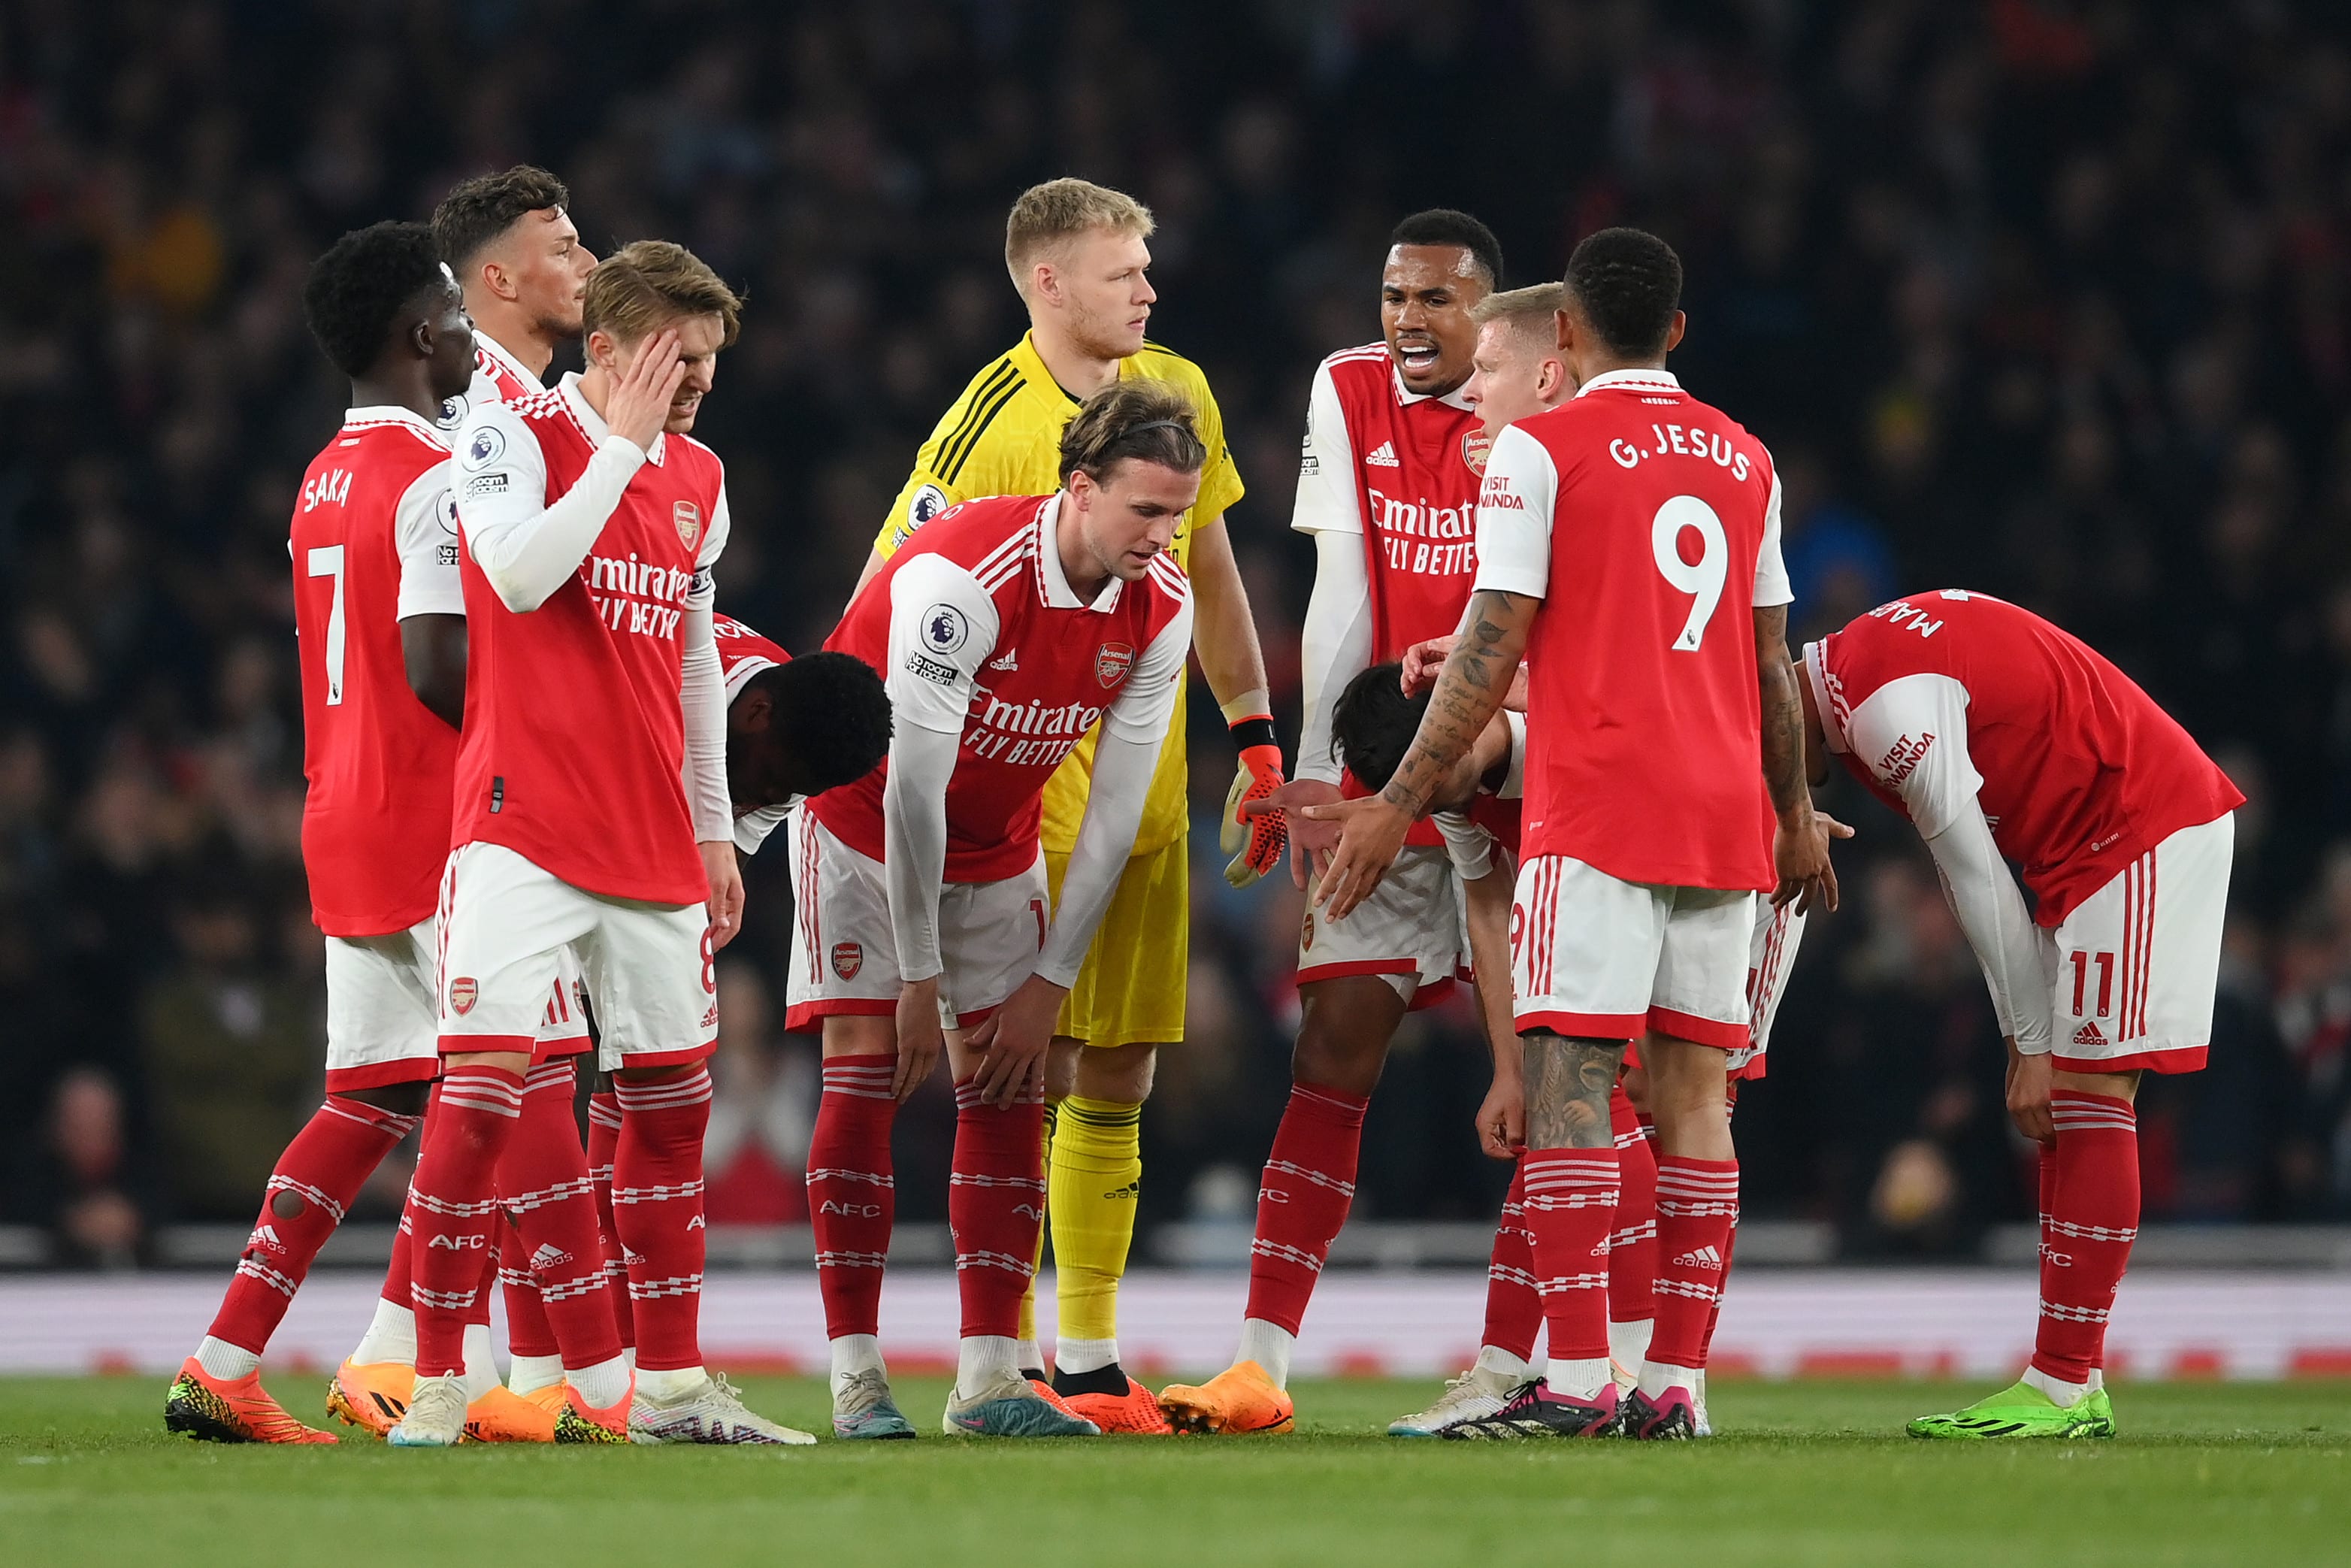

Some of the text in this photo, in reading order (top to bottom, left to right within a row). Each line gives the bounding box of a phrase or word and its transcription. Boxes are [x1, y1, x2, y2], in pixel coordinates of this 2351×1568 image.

[1366, 456, 1399, 468] adidas
[1609, 424, 1750, 482] G. JESUS
[304, 468, 353, 513] SAKA
[1484, 476, 1510, 492] VISIT
[1368, 487, 1479, 539] Emirat
[1413, 541, 1475, 576] BETTE
[1651, 495, 1729, 652] 9
[307, 544, 346, 706] 7
[909, 650, 953, 678] No room
[1101, 649, 1131, 661] Arsenal
[968, 681, 1101, 735] Emirate
[964, 727, 1011, 759] FLY
[1878, 733, 1913, 771] VISIT
[2069, 950, 2115, 1018] 11
[2073, 1037, 2109, 1046] adidas
[819, 1199, 882, 1218] AFC
[1257, 1188, 1290, 1203] FC
[428, 1234, 486, 1251] AFC
[1672, 1255, 1723, 1272] adidas
